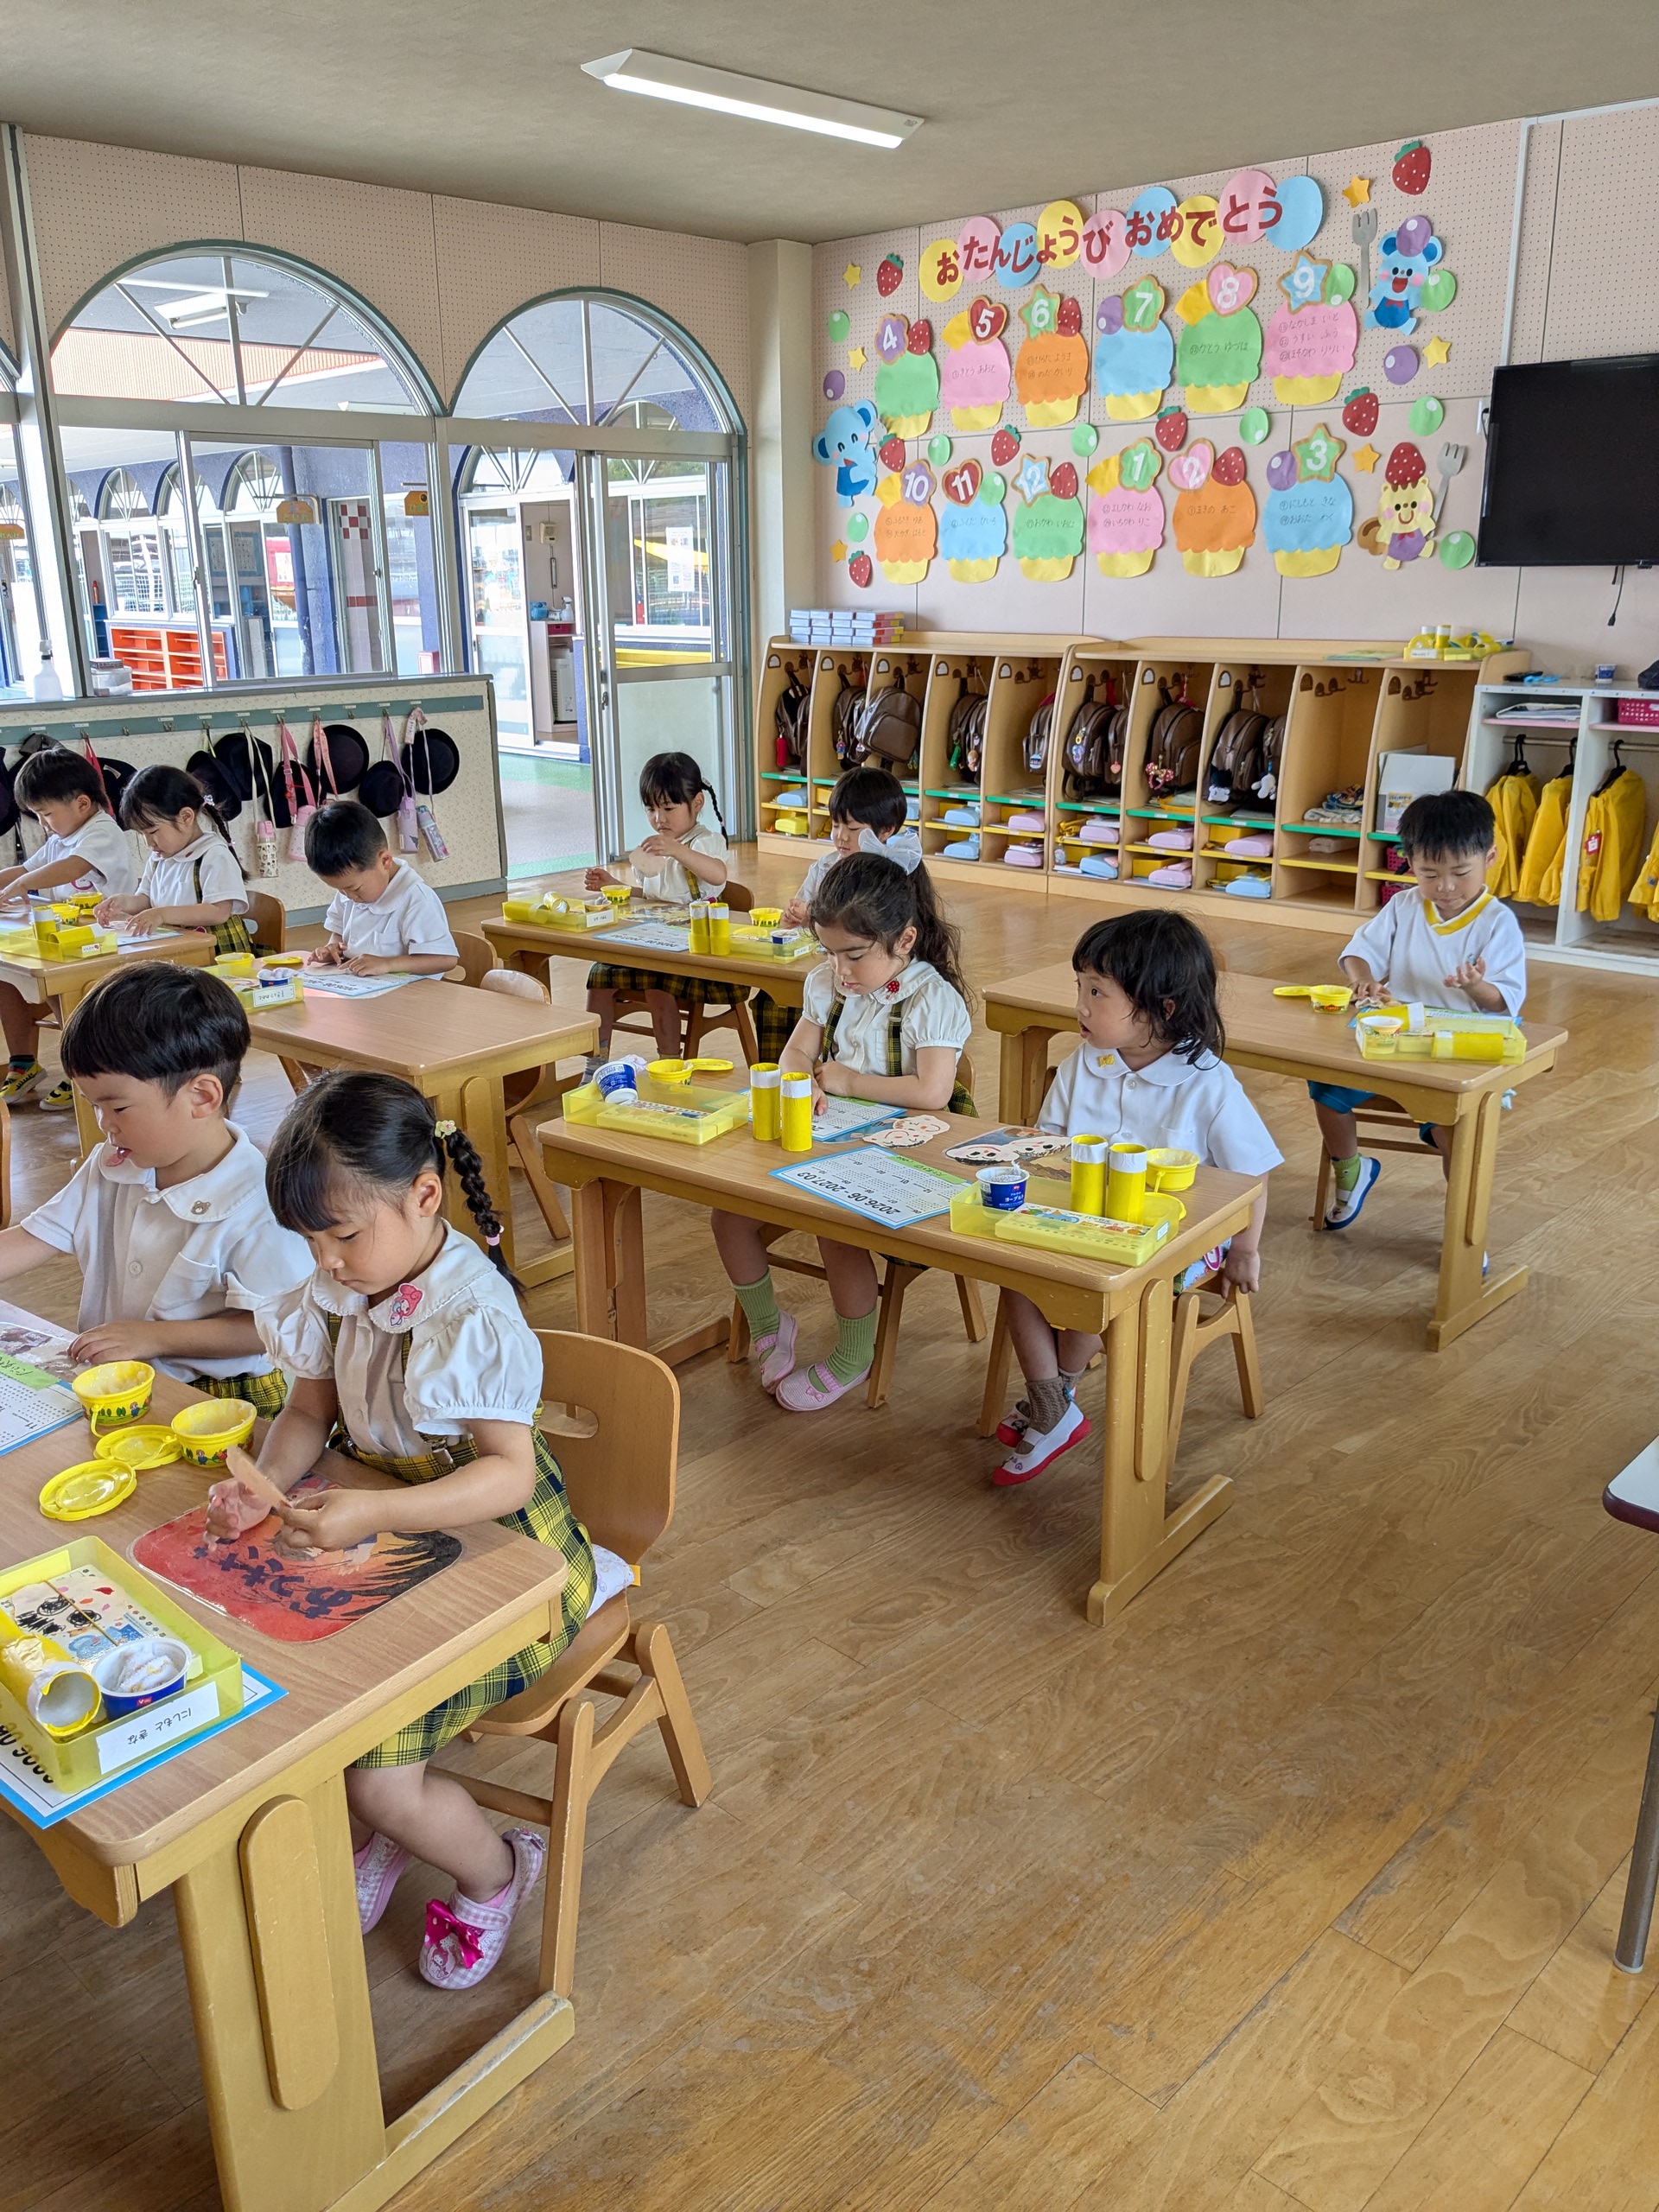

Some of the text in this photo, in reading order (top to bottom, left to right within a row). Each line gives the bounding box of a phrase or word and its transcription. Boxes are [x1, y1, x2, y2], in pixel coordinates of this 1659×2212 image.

[937, 186, 1283, 286] おたんじょうび おめでとう
[1217, 276, 1240, 308] 8
[1294, 266, 1315, 298] 9
[1031, 299, 1050, 328] 6
[1135, 292, 1153, 322] 7
[883, 324, 898, 351] 4
[976, 308, 995, 338] 5
[1133, 452, 1145, 481] 1
[1306, 440, 1327, 471] 3
[905, 472, 929, 501] 10
[951, 470, 974, 501] 11
[1018, 465, 1046, 499] 12
[1183, 456, 1205, 489] 2
[797, 1172, 845, 1193] 2027.03
[848, 1192, 901, 1215] 2026.06
[127, 1707, 192, 1746] にしもと きな
